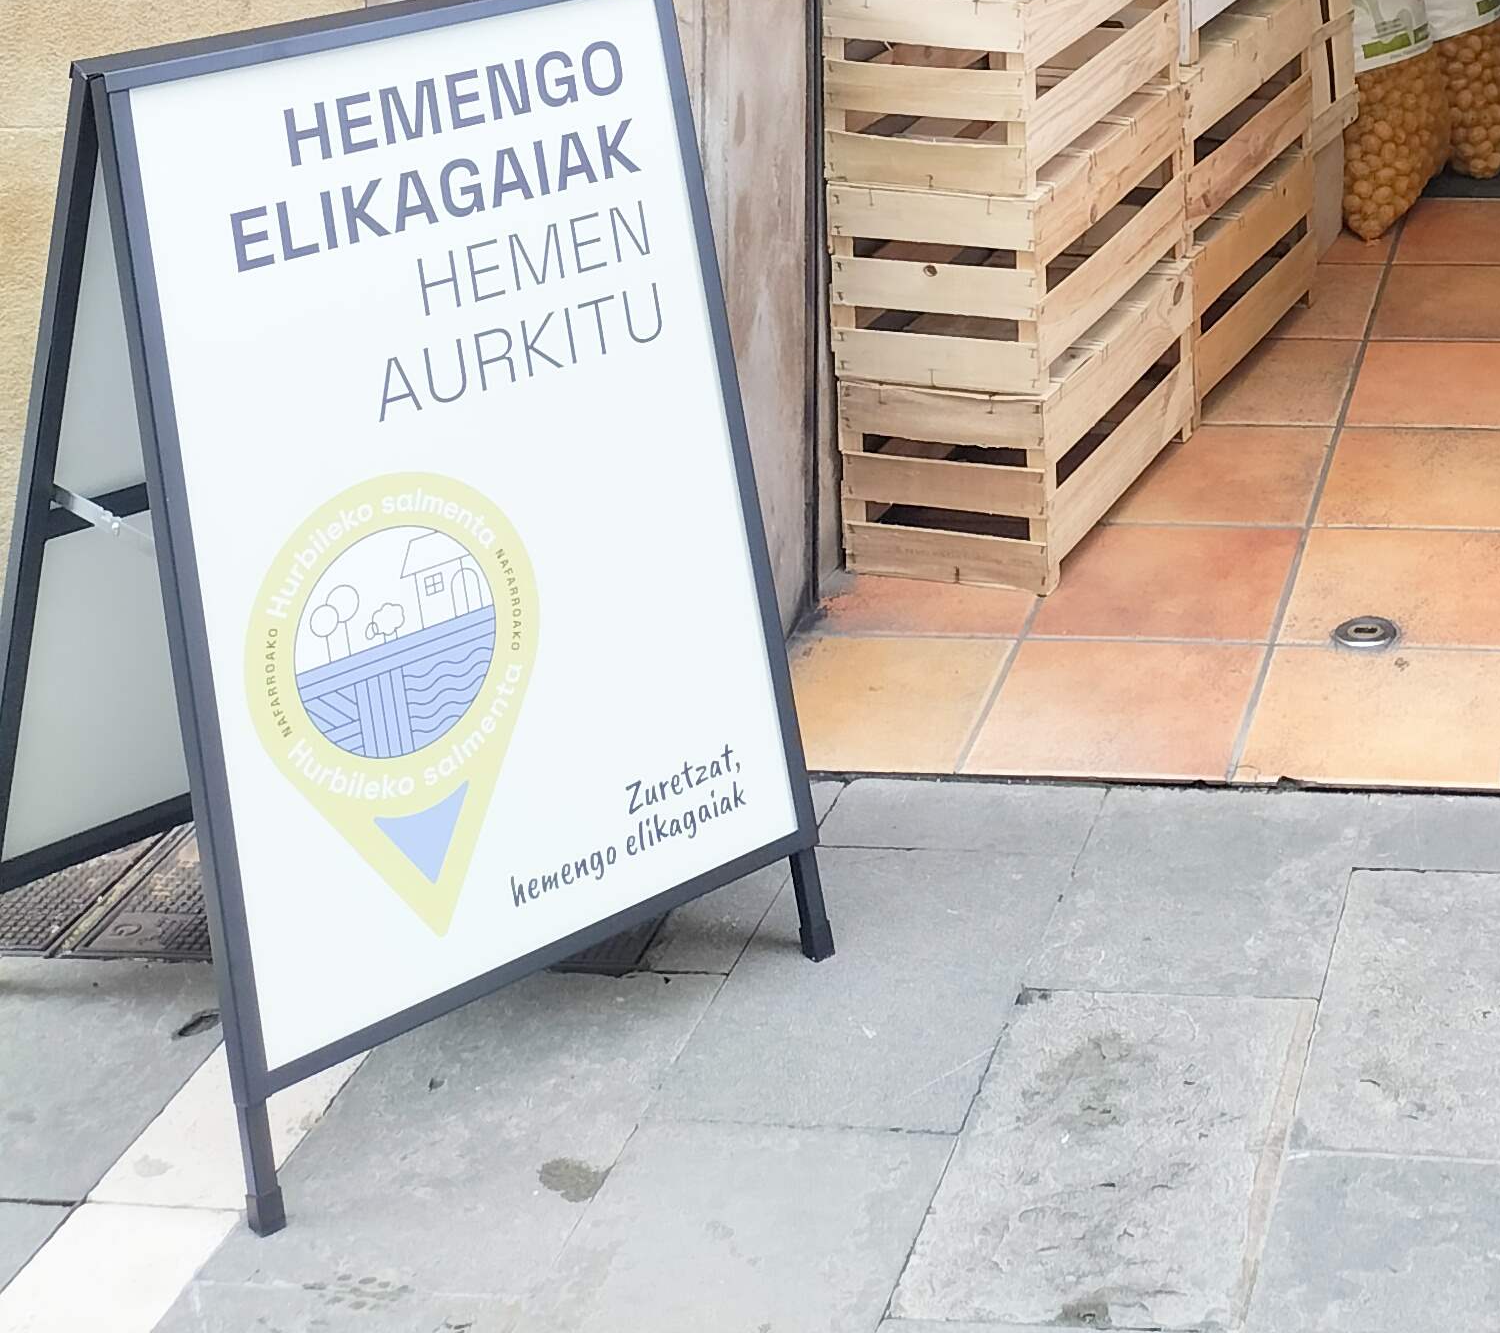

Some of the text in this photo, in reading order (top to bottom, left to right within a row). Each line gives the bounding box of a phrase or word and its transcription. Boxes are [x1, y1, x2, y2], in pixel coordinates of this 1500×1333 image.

[283, 39, 625, 168] HEMENGO
[229, 118, 642, 273] ELIKAGAIAK
[416, 199, 654, 317] HEMEN
[378, 281, 666, 423] AURKITU
[266, 488, 497, 620] Hurbileko salmenta
[495, 548, 522, 652] NAFARROAKO
[265, 628, 293, 738] NAFARROAKO
[287, 663, 523, 800] Hurbileko salmenta
[625, 743, 742, 815] Zuretzat,
[510, 780, 747, 908] hemengo elikagaiak
